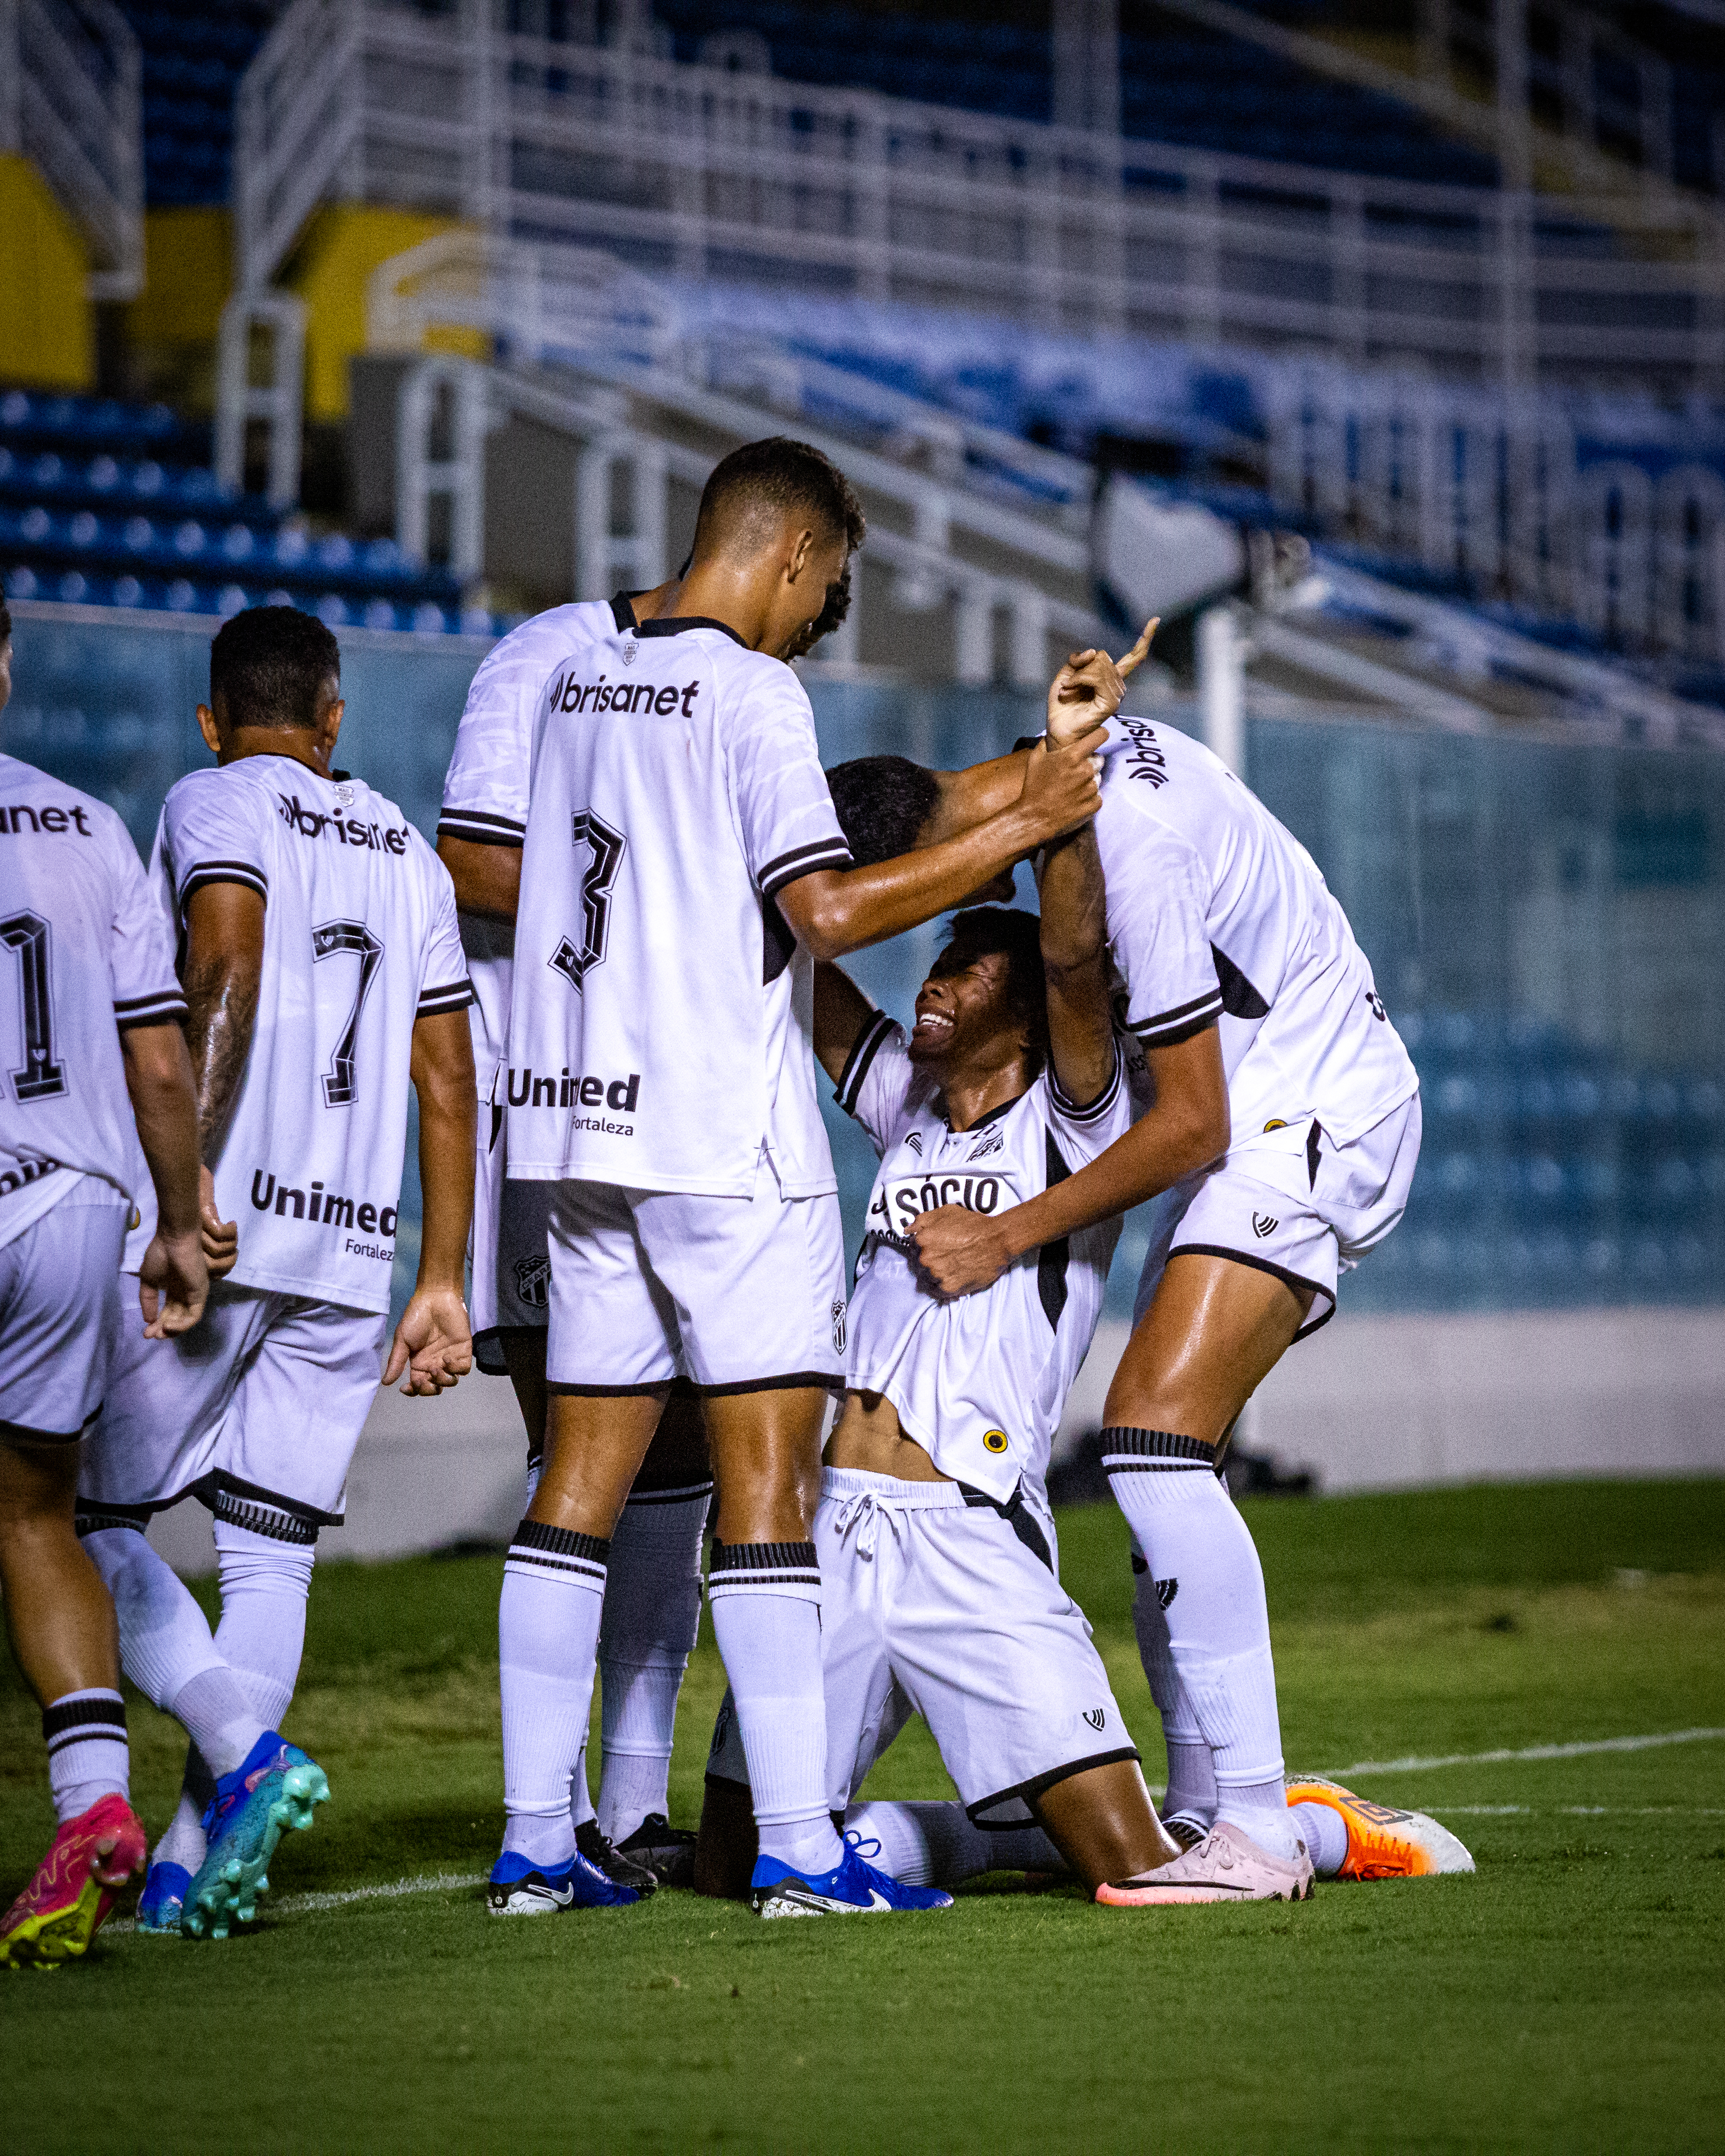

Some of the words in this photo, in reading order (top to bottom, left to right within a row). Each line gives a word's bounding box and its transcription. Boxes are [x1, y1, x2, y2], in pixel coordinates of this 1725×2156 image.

[560, 671, 700, 719] brisanet
[547, 807, 628, 997] 3
[312, 919, 385, 1109] 7
[572, 1115, 634, 1136] ortaleza
